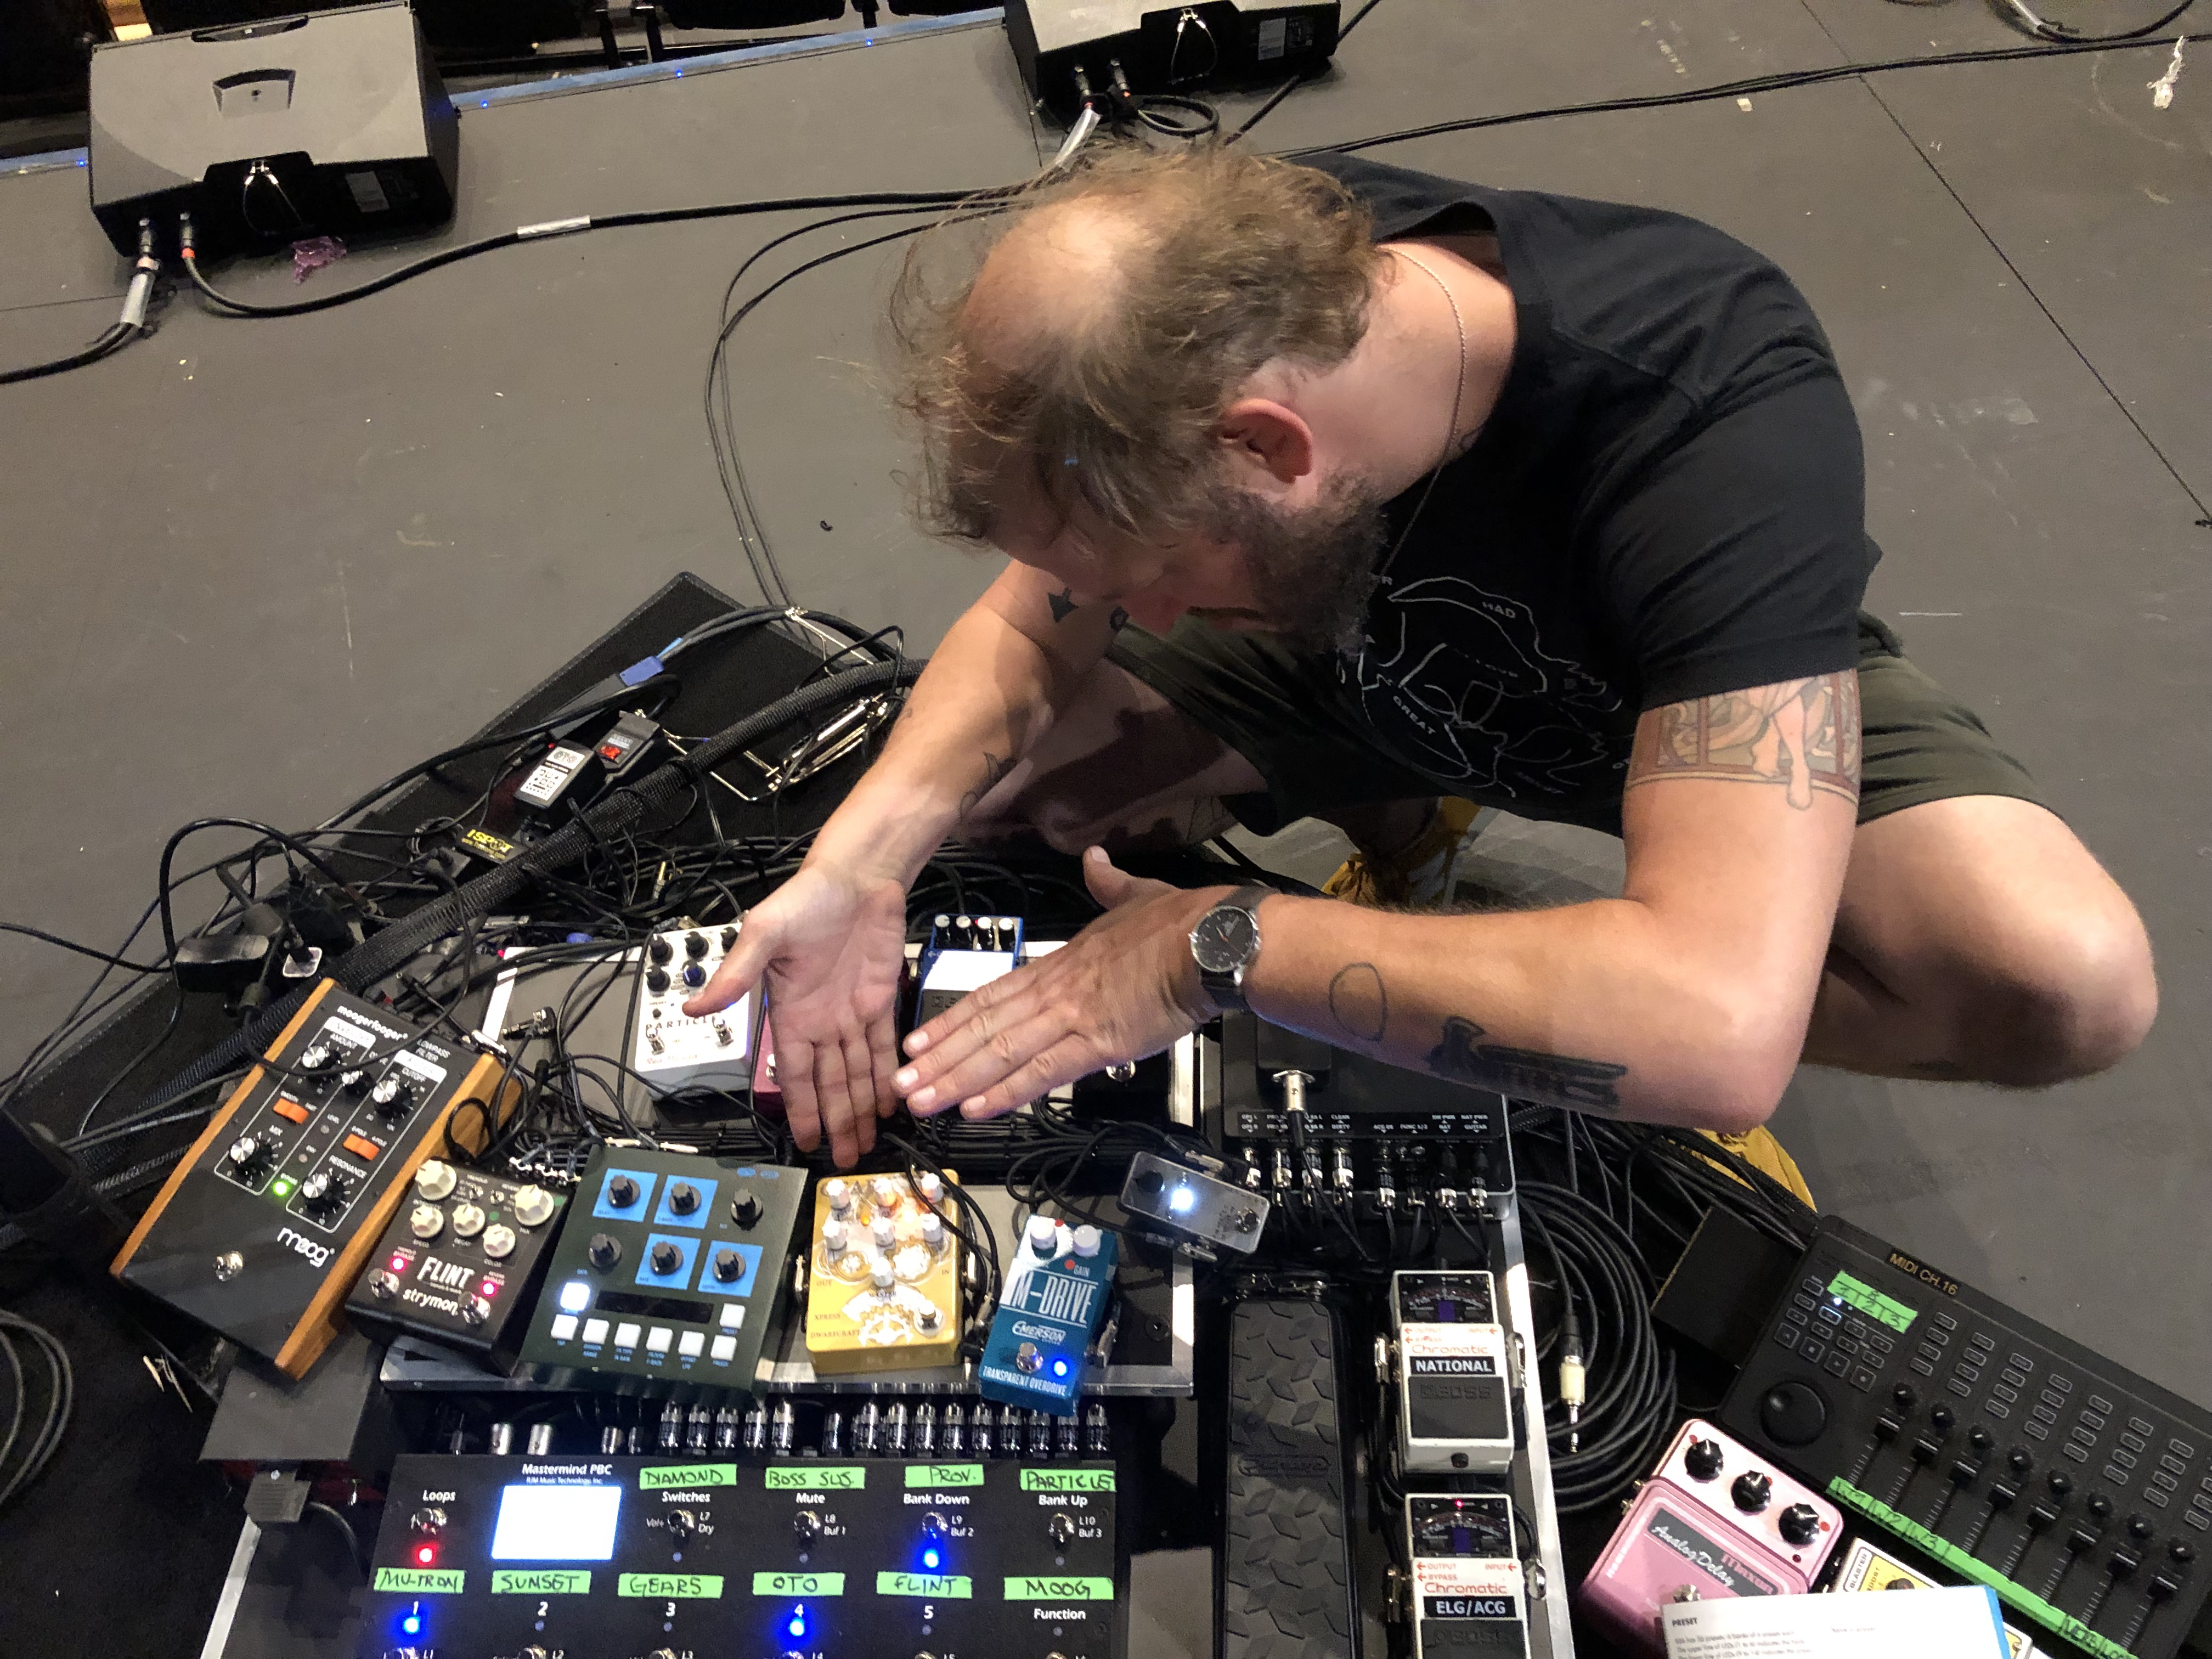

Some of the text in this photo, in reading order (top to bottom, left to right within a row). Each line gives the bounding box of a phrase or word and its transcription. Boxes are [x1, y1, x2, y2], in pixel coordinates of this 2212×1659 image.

[1393, 696, 1436, 735] GREAT
[337, 1006, 403, 1041] moogerfooger
[329, 1155, 368, 1179] RESONANCE
[277, 1227, 329, 1267] moog
[1074, 1264, 1091, 1278] GAIN
[1889, 1253, 1918, 1274] MIDI
[417, 1256, 476, 1289] FLINT
[402, 1288, 459, 1316] strymon
[1412, 1345, 1488, 1355] Chromatic
[1415, 1359, 1492, 1372] NATIONAL
[983, 1365, 1068, 1397] TRANSPARENT OVERDRIVE
[522, 1463, 613, 1475] Mastermind PBC
[645, 1469, 724, 1485] DIAMOND
[769, 1470, 806, 1487] BOSS
[1026, 1471, 1116, 1491] PARTICLE
[423, 1490, 456, 1503] Loops
[662, 1491, 711, 1503] Switches
[795, 1493, 826, 1504] Mute
[904, 1494, 970, 1505] Bank Down
[1039, 1495, 1088, 1508] Bank Up
[825, 1514, 836, 1523] L8
[951, 1515, 963, 1525] L9
[1079, 1516, 1096, 1525] L10
[824, 1526, 840, 1536] Buf
[951, 1527, 974, 1537] Buf 2
[1079, 1528, 1102, 1538] Buf 3
[1651, 1526, 1735, 1586] Analog Delay
[1849, 1554, 1867, 1589] BLASTER
[500, 1573, 580, 1592] SUNSET
[630, 1576, 702, 1597] GEARS
[772, 1576, 819, 1593] OTO
[894, 1575, 957, 1597] FLINT
[1025, 1579, 1091, 1600] MOOG
[1425, 1582, 1508, 1595] Chromatic
[413, 1601, 419, 1615] 1
[537, 1601, 548, 1617] 2
[665, 1602, 676, 1617] 3
[794, 1604, 804, 1617] 4
[923, 1605, 934, 1620] 5
[1034, 1608, 1087, 1620] Function
[1436, 1600, 1506, 1617] ELG/ACG
[1672, 1617, 1697, 1627] PRESET
